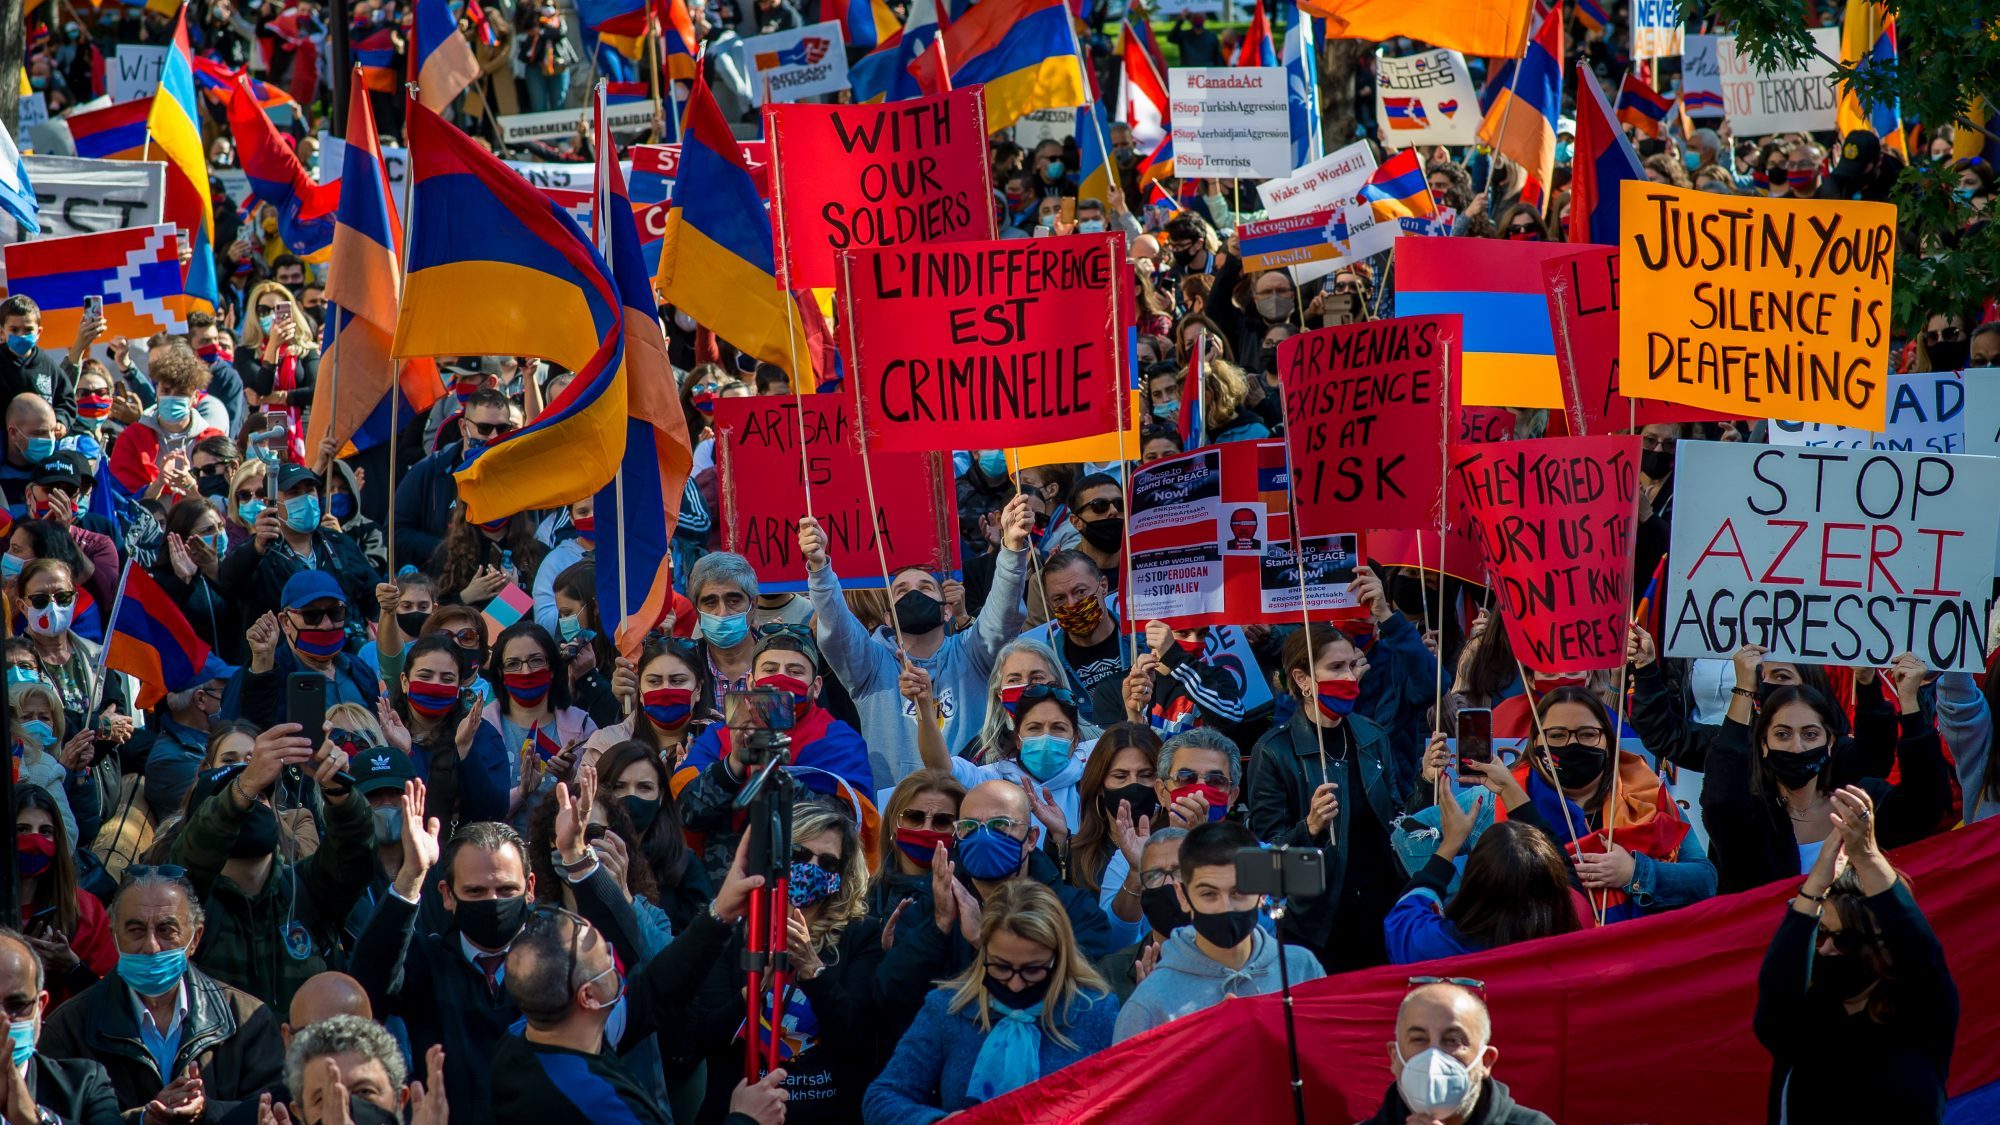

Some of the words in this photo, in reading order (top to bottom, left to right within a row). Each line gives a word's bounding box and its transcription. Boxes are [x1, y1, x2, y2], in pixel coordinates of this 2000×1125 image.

[1187, 74, 1263, 89] #CanadaAct
[1722, 81, 1755, 117] STOP
[829, 99, 951, 153] WITH
[1173, 100, 1288, 116] #StopTurkishAggression
[1173, 128, 1290, 142] #StopAzerbaidjaniAggression
[860, 156, 943, 202] OUR
[1177, 154, 1251, 169] #StopTerrorists
[1270, 184, 1300, 203] Wake
[1303, 178, 1317, 192] up
[1317, 161, 1352, 181] World
[822, 191, 971, 248] SOLDIERS
[1312, 197, 1346, 213] ilence
[1245, 215, 1315, 237] Recognize
[1349, 216, 1375, 237] ives!
[1260, 249, 1312, 267] Artsakh
[1808, 212, 1894, 285] YOUR
[873, 242, 1111, 299] L'INDIFFÉRENCE
[950, 297, 1039, 346] EST
[1690, 282, 1837, 336] SILENCE
[1289, 322, 1437, 386] ARMENIA'S
[880, 343, 1094, 423] CRIMINELLE
[1288, 370, 1431, 427] EXISTENCE
[739, 404, 848, 453] ARTSAK
[1307, 423, 1327, 453] IS
[1339, 415, 1377, 448] AT
[1136, 479, 1161, 495] Stand
[1162, 477, 1176, 486] for
[1177, 468, 1209, 483] PEACE
[1172, 467, 1182, 475] to
[1455, 452, 1525, 509] THEY
[1607, 450, 1635, 503] TO
[1747, 449, 1954, 521] STOP
[745, 499, 895, 567] ARMNiA
[1306, 545, 1316, 553] to
[1136, 561, 1158, 570] WAKE
[1137, 566, 1209, 584] #STOPERDOGAN
[1265, 558, 1294, 568] Stand
[1311, 551, 1346, 562] PEACE
[1686, 517, 1966, 597] AZERI
[1144, 581, 1200, 598] #STOPALIEV
[1268, 597, 1348, 609] #stopazeaggression
[1271, 591, 1344, 602] #RecogzeArtsakh
[1522, 619, 1607, 665] WERE
